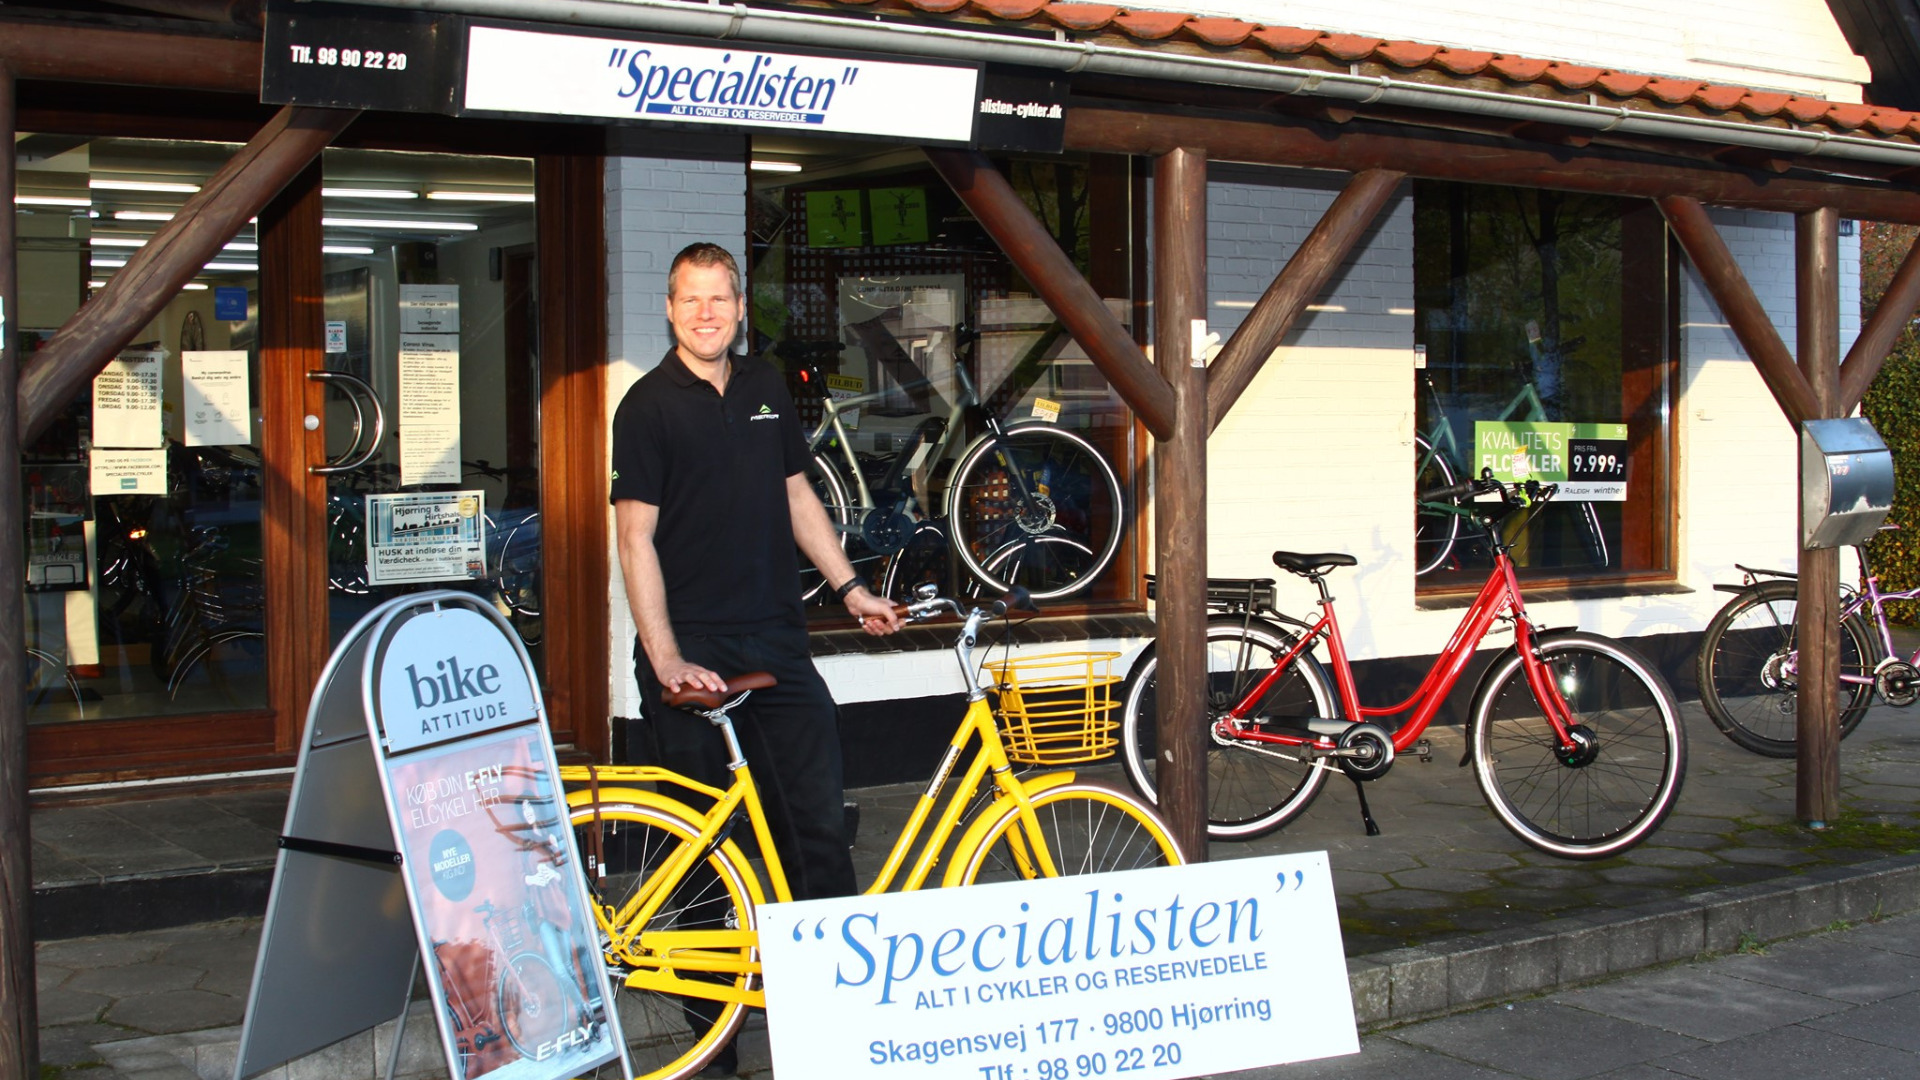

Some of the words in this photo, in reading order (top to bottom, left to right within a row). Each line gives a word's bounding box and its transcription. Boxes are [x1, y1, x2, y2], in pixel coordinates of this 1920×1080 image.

[290, 45, 313, 64] Tlf.
[317, 47, 338, 66] 98
[341, 49, 361, 67] 90
[363, 50, 384, 69] 22
[386, 52, 407, 71] 20
[671, 105, 687, 114] ALT
[696, 107, 729, 118] CYKLER
[732, 109, 745, 119] OG
[748, 110, 807, 123] RESERVEDELE
[829, 378, 863, 389] TILBUD
[1482, 431, 1562, 450] KVALITETS
[1594, 486, 1624, 494] winther
[395, 506, 431, 516] Hjørring
[425, 512, 460, 520] Hirtshals
[379, 556, 420, 565] Værdicheck
[405, 655, 501, 710] bike
[421, 702, 508, 735] ATTITUDE
[406, 781, 437, 806] KØB
[438, 774, 463, 798] DIN
[465, 763, 502, 790] E-FLY
[411, 796, 472, 829] ELCYKEL
[472, 787, 501, 812] HER
[434, 853, 471, 872] MODELLER
[442, 847, 458, 860] NYE
[914, 987, 957, 1011] ALT
[964, 986, 970, 1005] I
[977, 975, 1069, 1004] CYKLER
[1075, 970, 1108, 992] OG
[1115, 951, 1268, 988] RESERVEDELE
[869, 1024, 1027, 1065] Skagensvej
[1035, 1017, 1079, 1045] 177
[1103, 1008, 1163, 1036] 9800
[1172, 994, 1272, 1030] Hjørring
[536, 1022, 595, 1062] E-FLY
[1037, 1057, 1069, 1080] 98
[1076, 1053, 1107, 1078] 90
[1114, 1047, 1145, 1073] 22
[1151, 1042, 1182, 1068] 20
